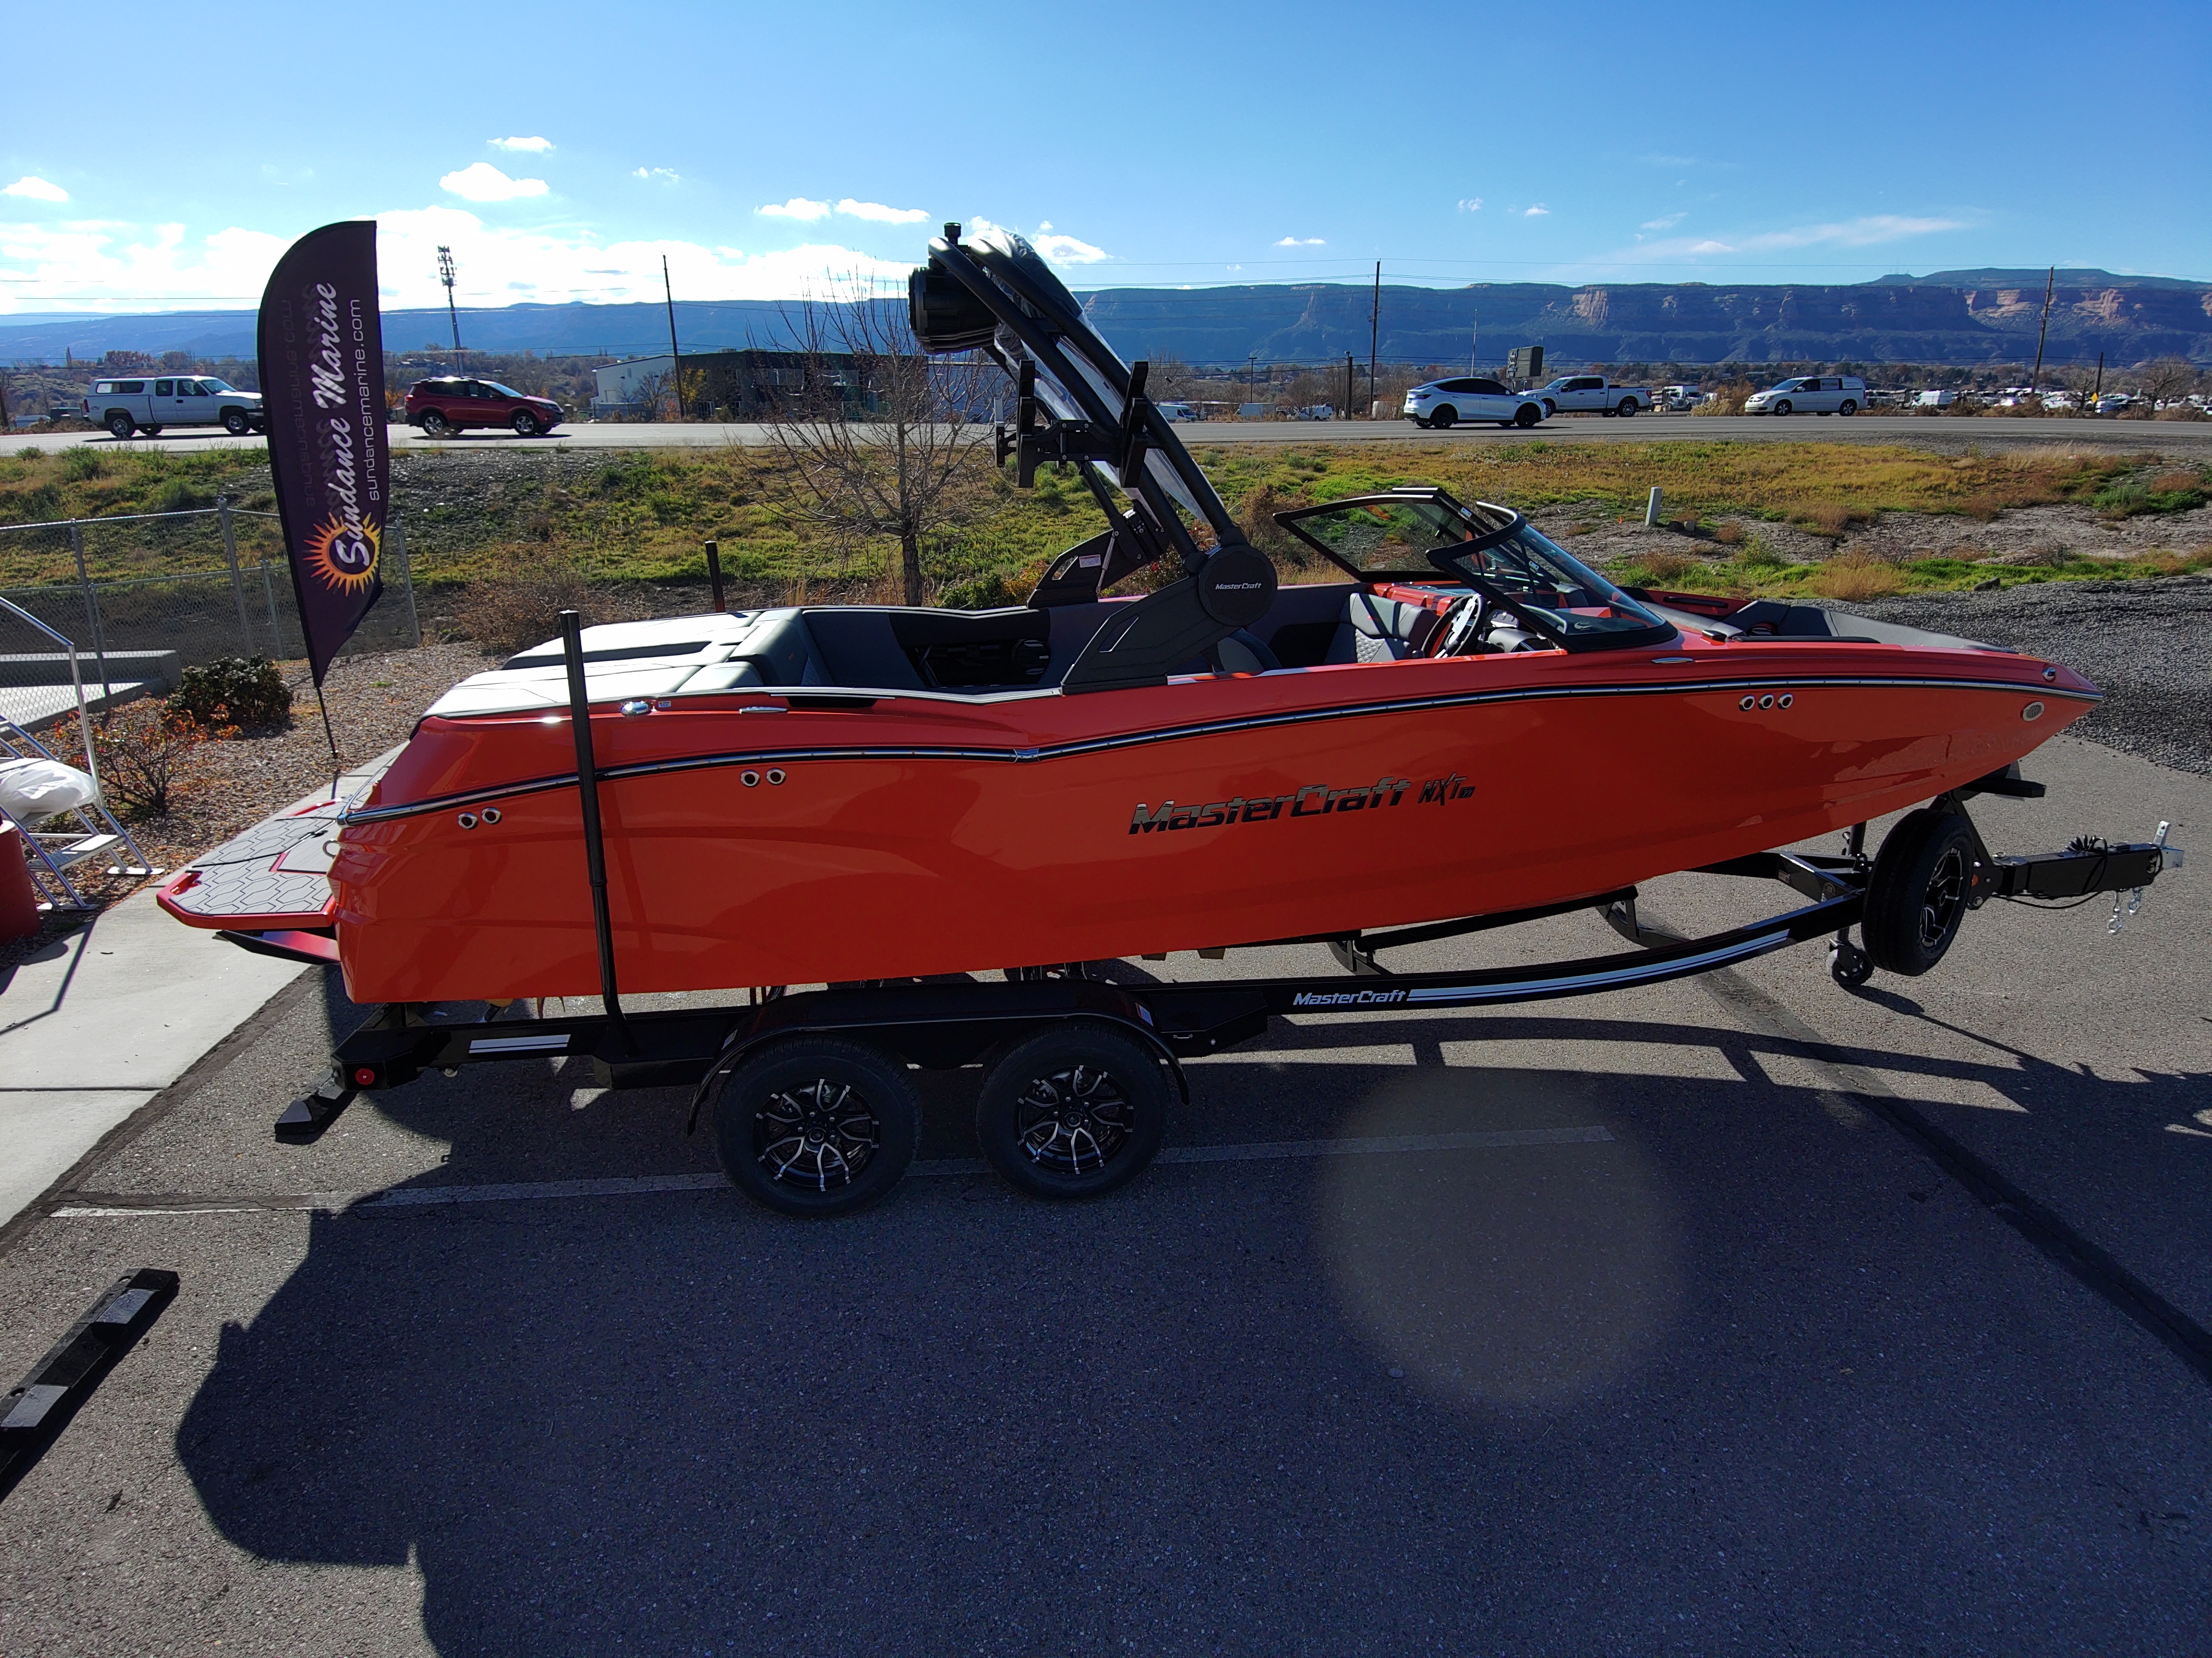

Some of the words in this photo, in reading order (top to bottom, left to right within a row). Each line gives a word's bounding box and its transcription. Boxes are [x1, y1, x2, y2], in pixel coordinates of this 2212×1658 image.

[311, 283, 346, 408] Marine
[350, 299, 380, 501] sundancemarine.com
[328, 417, 370, 567] Sundance
[1129, 777, 1411, 834] MasterCraft
[1293, 989, 1406, 1005] MasterCraft
